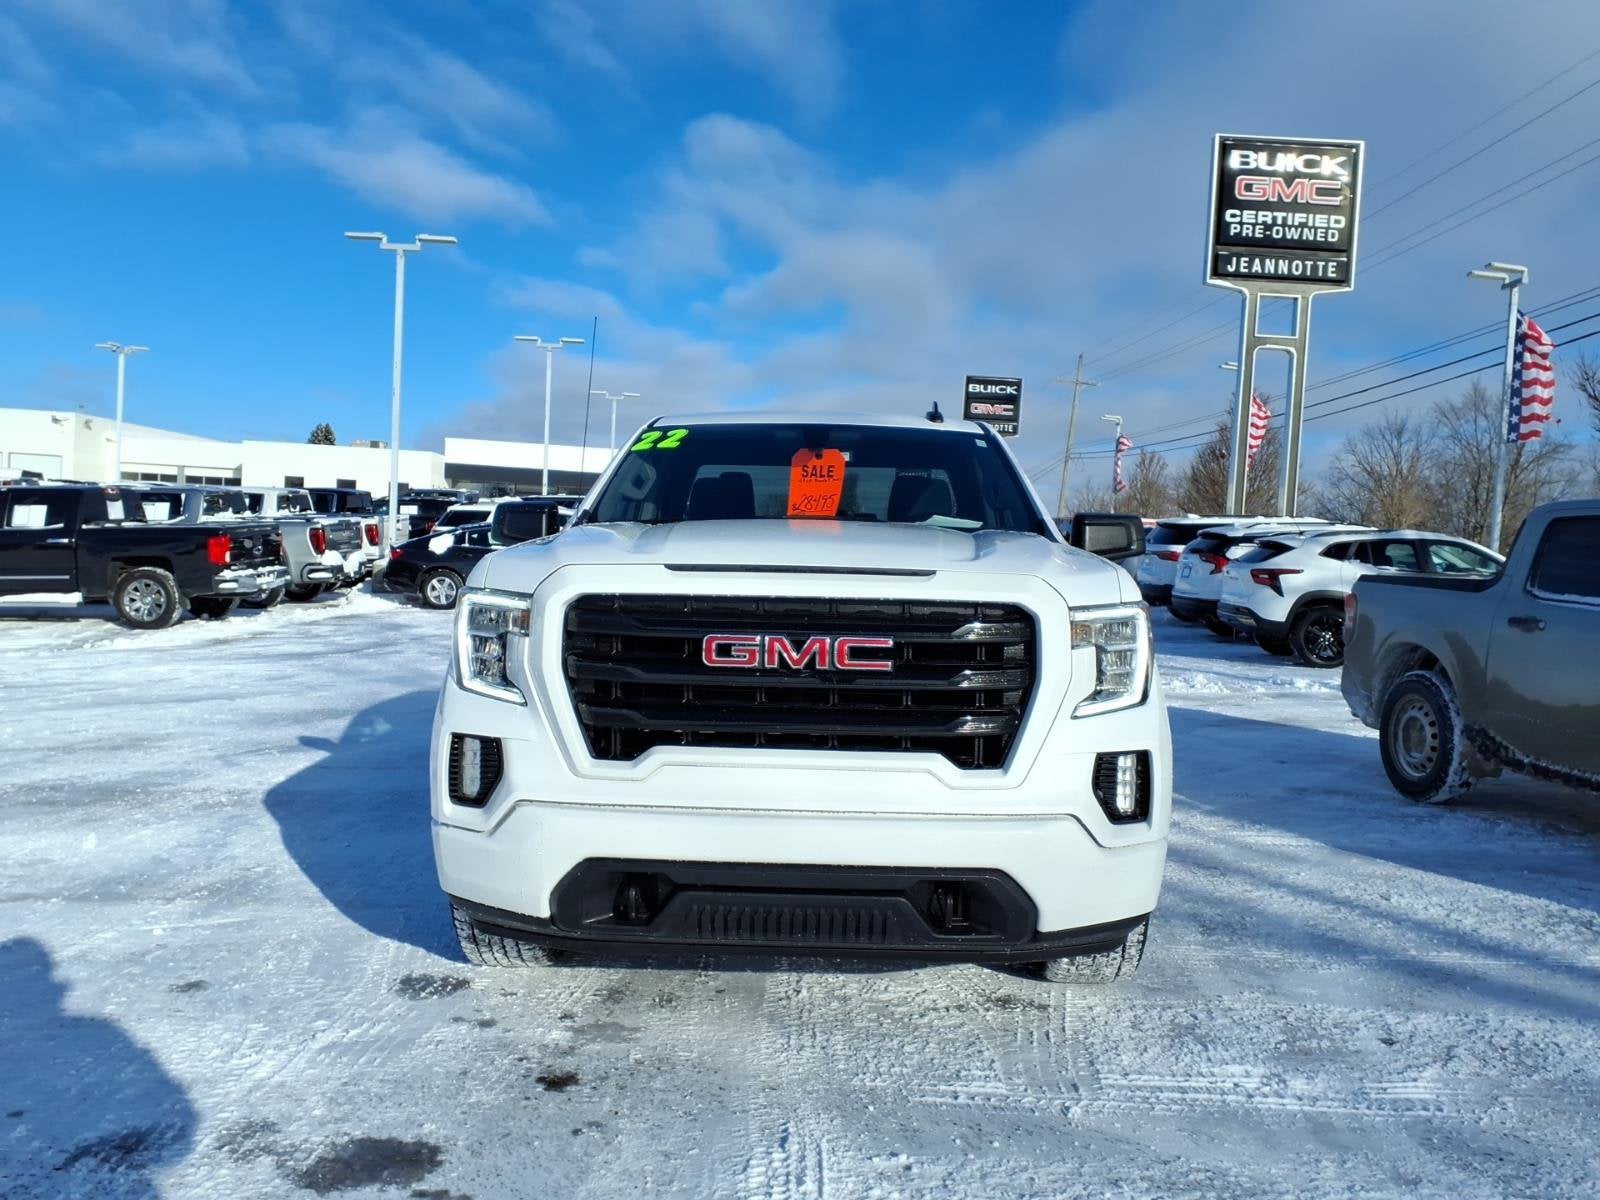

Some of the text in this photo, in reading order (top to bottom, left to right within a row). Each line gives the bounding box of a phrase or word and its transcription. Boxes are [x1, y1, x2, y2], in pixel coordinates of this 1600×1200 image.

[1228, 149, 1349, 176] BUICK
[1235, 175, 1342, 206] GMC
[1224, 209, 1346, 229] CERTIFIED
[1230, 224, 1339, 242] PRE-OWNED
[1227, 257, 1338, 278] JEANNOTTE
[968, 383, 1018, 395] BUICK
[970, 402, 1014, 416] GMC
[991, 423, 1014, 433] OTTE
[630, 428, 689, 451] 22
[801, 464, 836, 479] SALE
[702, 634, 894, 671] GMC
